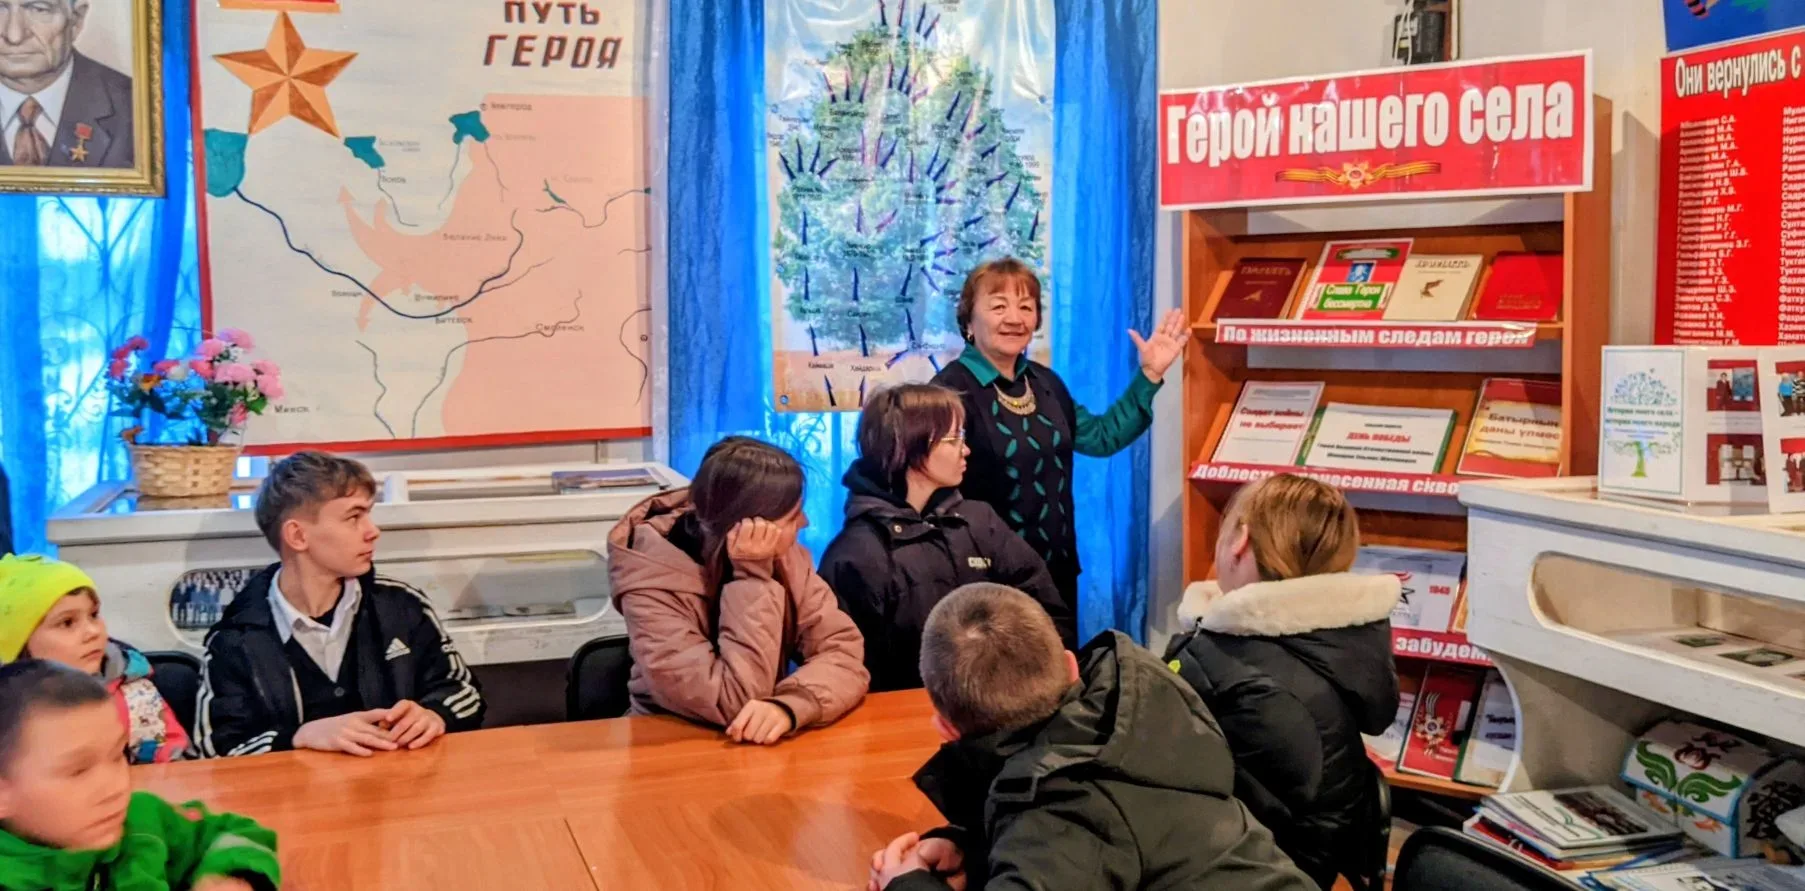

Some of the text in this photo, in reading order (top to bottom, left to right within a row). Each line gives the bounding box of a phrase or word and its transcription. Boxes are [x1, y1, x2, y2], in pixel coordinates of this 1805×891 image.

[504, 0, 600, 25] ПУТЬ
[483, 34, 623, 69] ГЕРОЯ
[1675, 44, 1801, 99] Они вернулись с
[1166, 81, 1573, 168] Герой нашего села
[1223, 325, 1247, 342] По
[1251, 326, 1375, 344] жизненным
[1378, 328, 1462, 346] следам
[1412, 477, 1460, 494] скво
